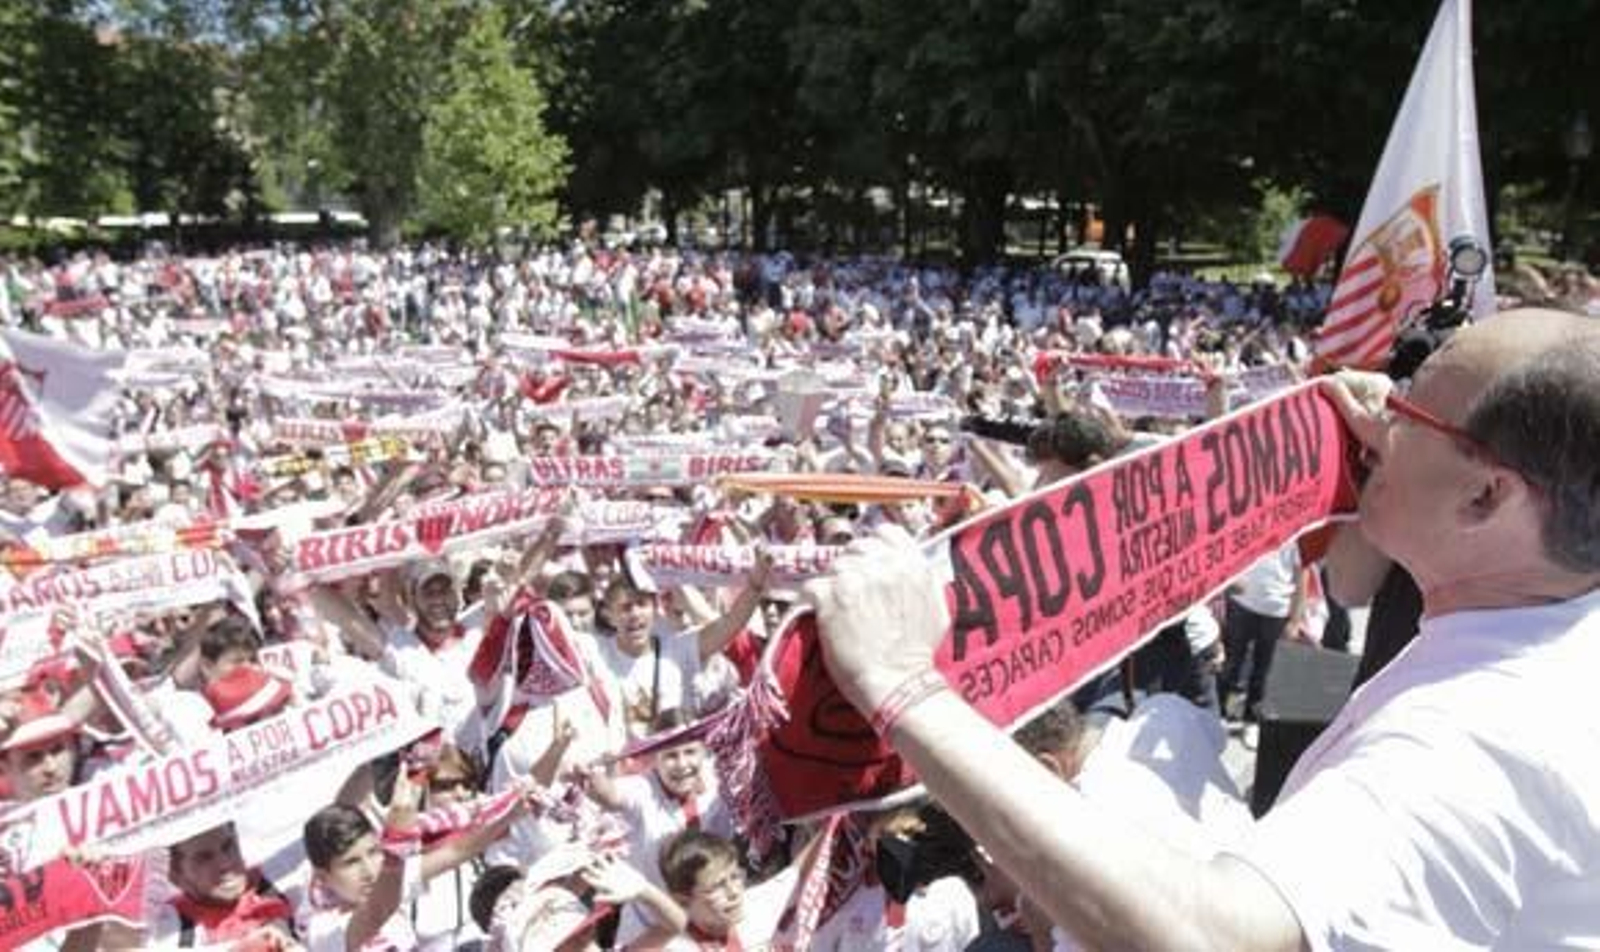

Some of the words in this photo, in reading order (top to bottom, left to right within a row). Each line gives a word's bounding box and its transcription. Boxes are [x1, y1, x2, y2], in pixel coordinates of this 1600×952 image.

[688, 455, 766, 477] BIRIS
[298, 524, 409, 572] BIRIS
[6, 574, 101, 608] AMOS
[59, 749, 219, 847] VAMOS
[227, 737, 245, 766] A
[250, 719, 296, 751] POR
[303, 684, 397, 750] COPA
